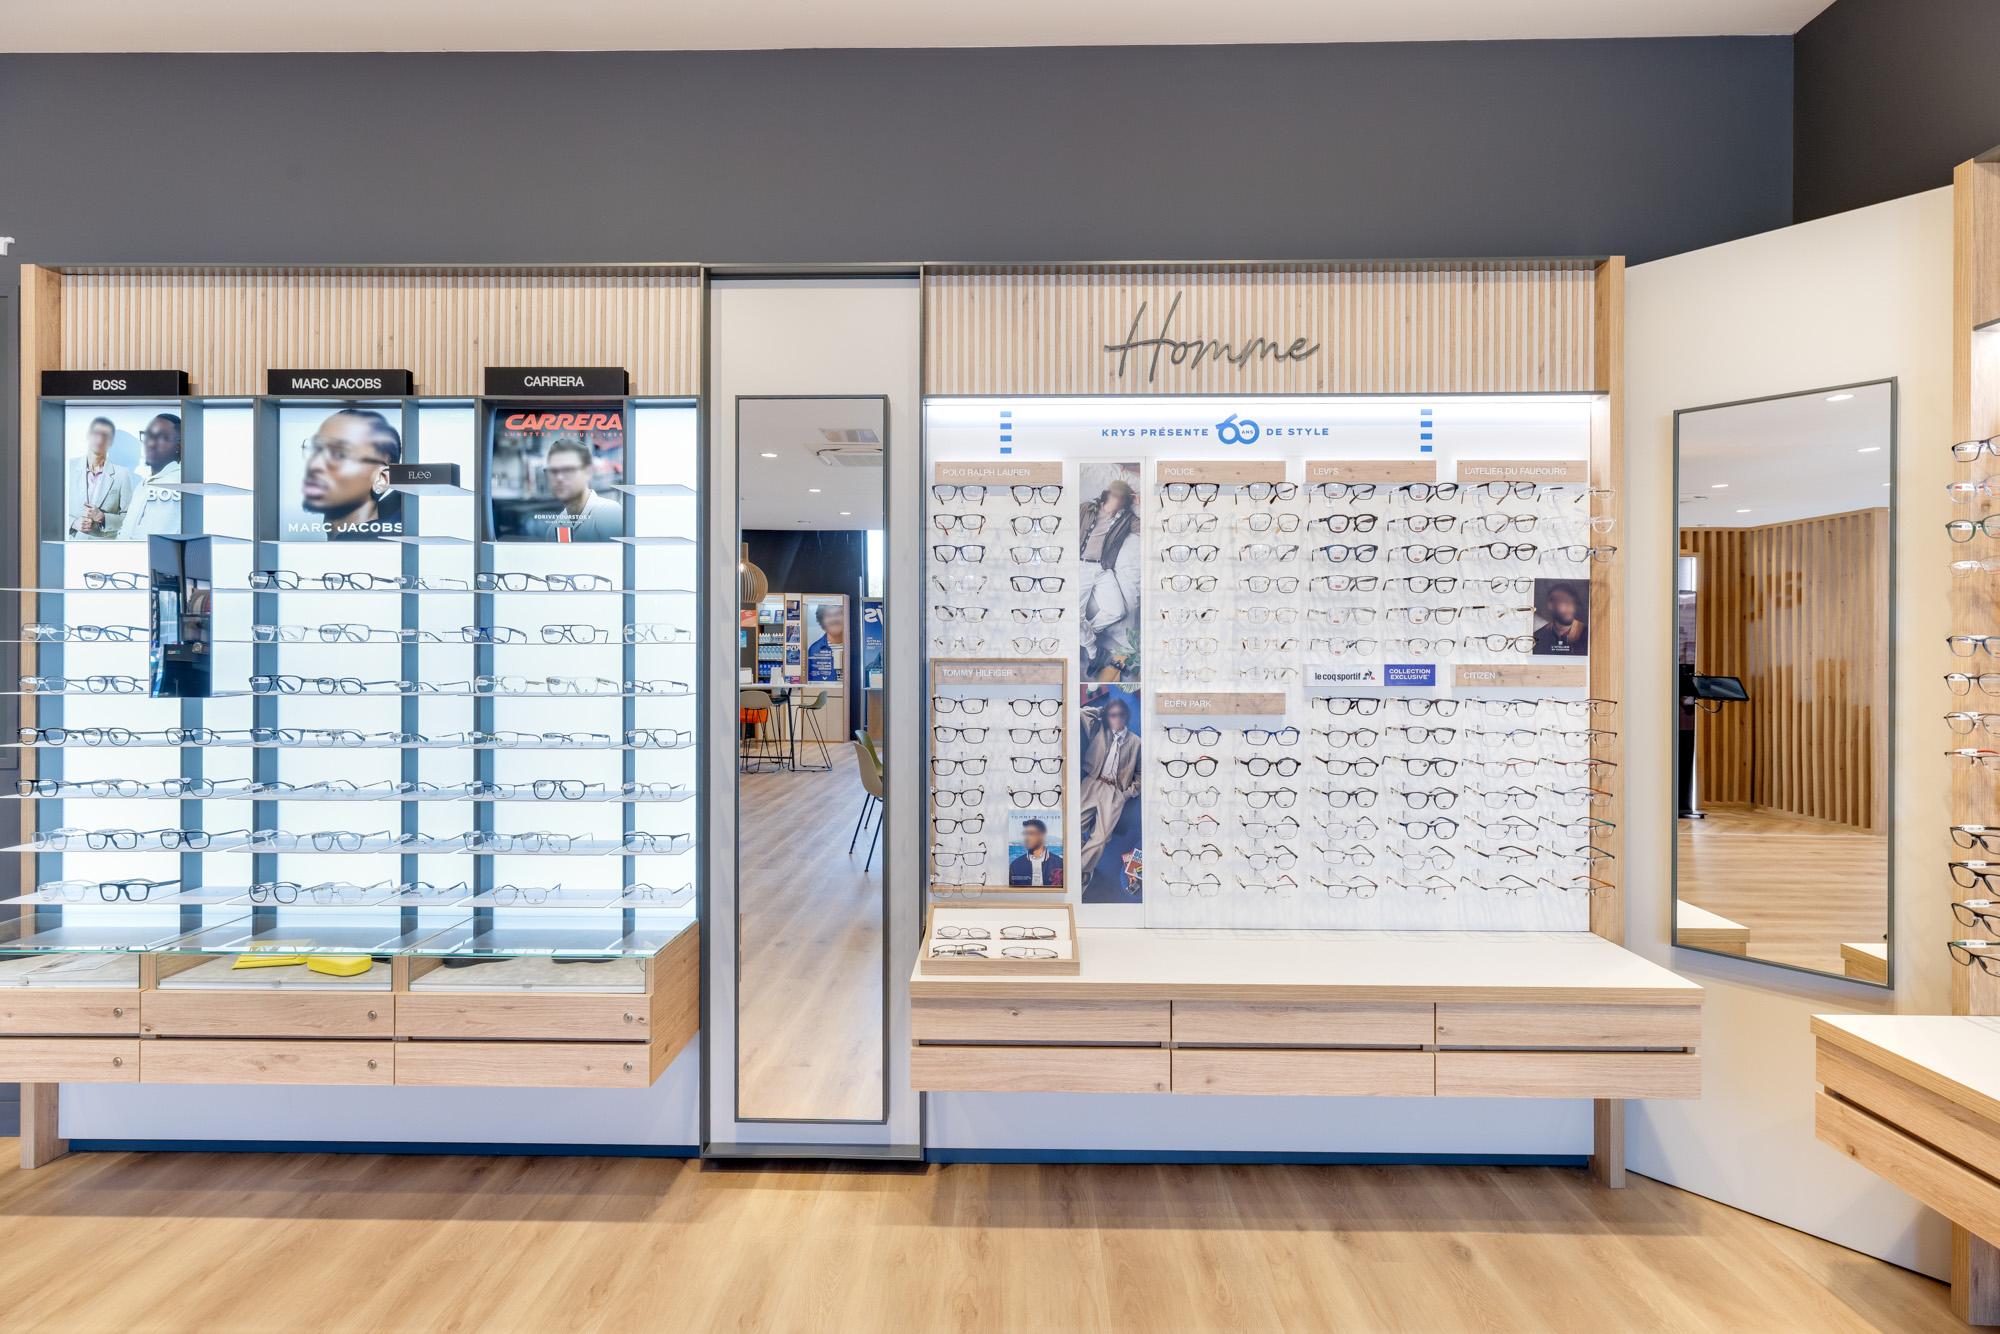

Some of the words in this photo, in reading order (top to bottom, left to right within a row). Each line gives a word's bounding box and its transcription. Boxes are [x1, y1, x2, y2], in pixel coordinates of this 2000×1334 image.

[1104, 291, 1320, 383] Homme
[92, 379, 127, 391] BOSS
[291, 378, 329, 389] MARC
[331, 378, 382, 390] JACOBS
[524, 376, 585, 387] CARRERA
[505, 413, 623, 431] CARRERA
[1102, 428, 1136, 437] KRYS
[1141, 426, 1209, 436] PRÉSENTE
[1215, 413, 1260, 445] 60
[1266, 428, 1283, 436] DE
[1288, 428, 1329, 436] STYLE
[942, 468, 966, 476] POLO
[967, 468, 995, 476] RALPH
[997, 468, 1031, 476] LAUREN
[1164, 467, 1195, 476] POLICE
[1504, 467, 1518, 475] DU
[1519, 467, 1567, 475] FAUBOURG
[146, 488, 182, 502] BOS
[288, 522, 333, 533] MARC
[337, 522, 403, 533] JACOBS
[943, 669, 974, 677] TOMMY
[975, 669, 1013, 677] HILFIGER
[1314, 672, 1322, 681] le
[1322, 673, 1337, 682] coq
[1337, 672, 1361, 682] sportif
[1463, 671, 1496, 680] CITIZEN
[1164, 700, 1187, 708] EDEN
[1189, 700, 1212, 708] PARK
